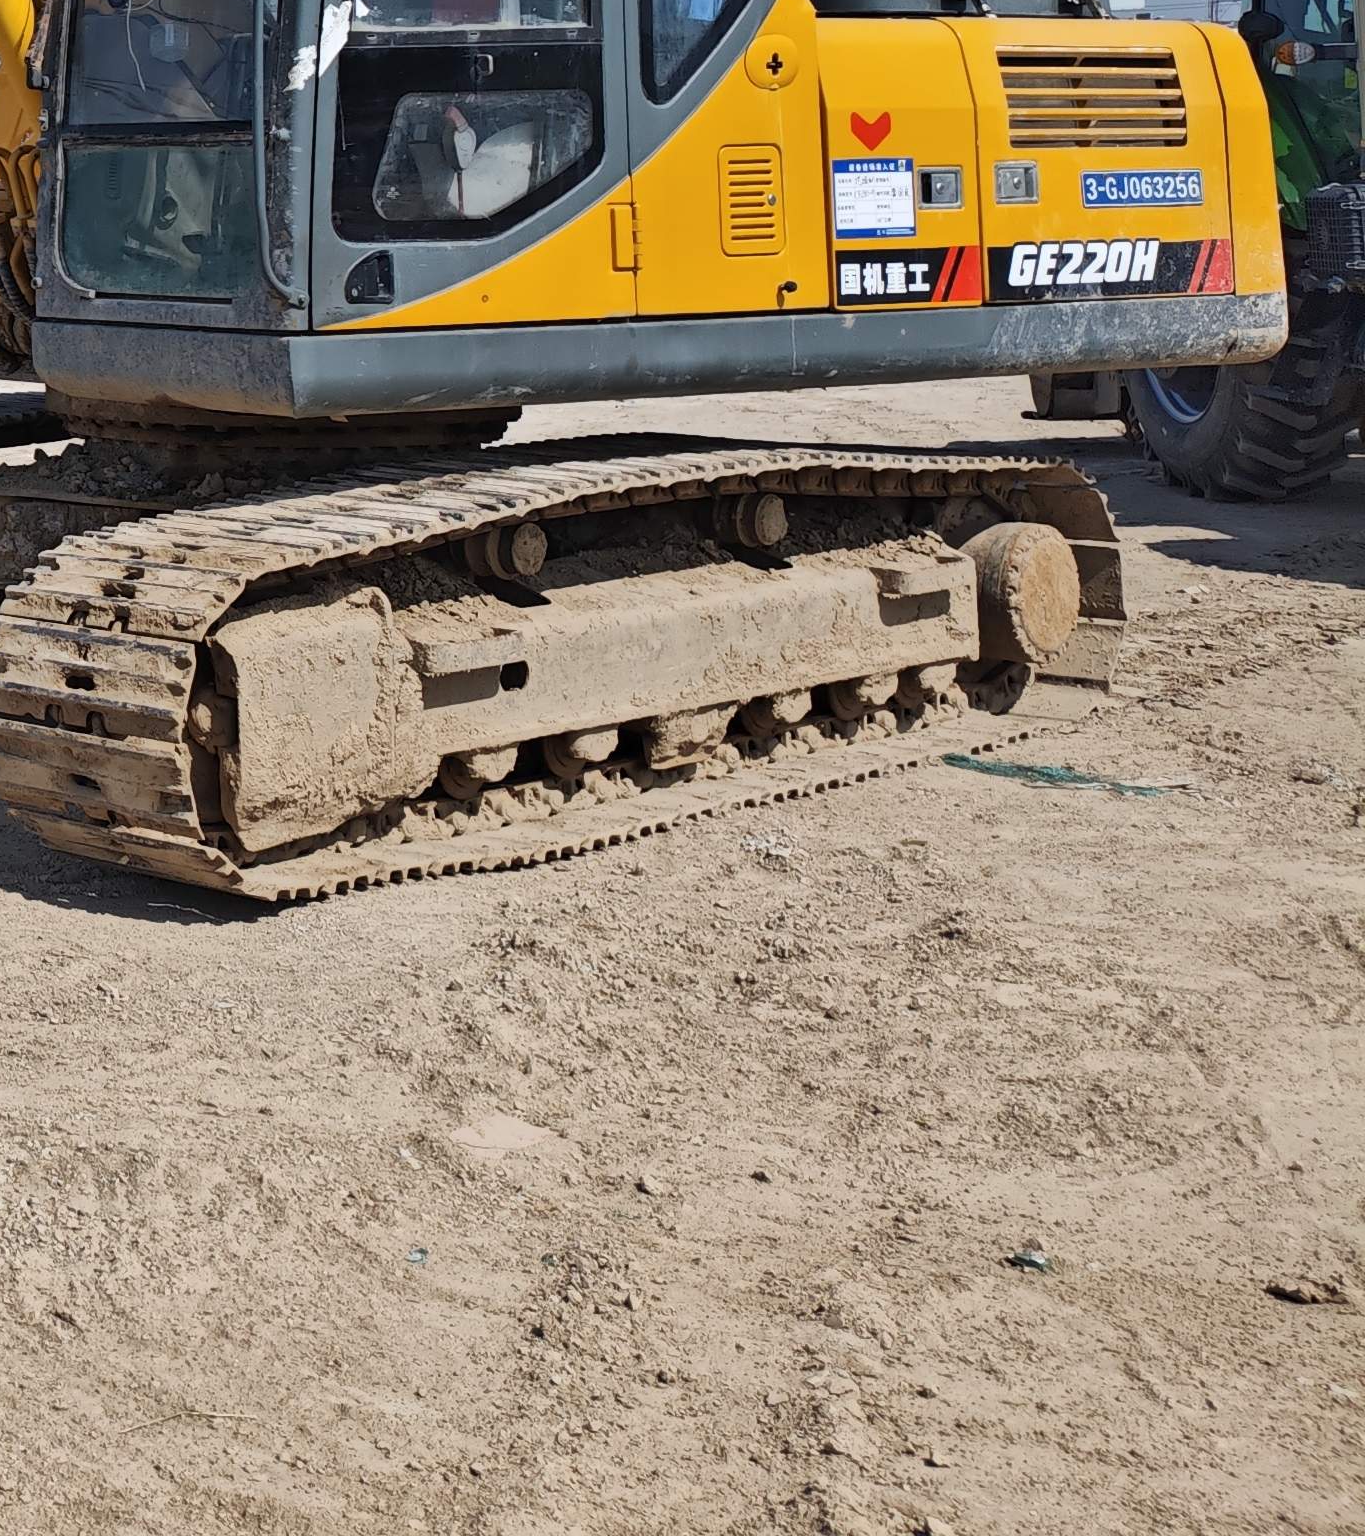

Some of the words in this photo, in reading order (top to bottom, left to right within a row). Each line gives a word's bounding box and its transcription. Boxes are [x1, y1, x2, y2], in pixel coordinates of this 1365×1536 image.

[1085, 175, 1200, 201] 3-GJ063256
[840, 262, 930, 295] 国机重工
[1008, 241, 1159, 286] GE220H
